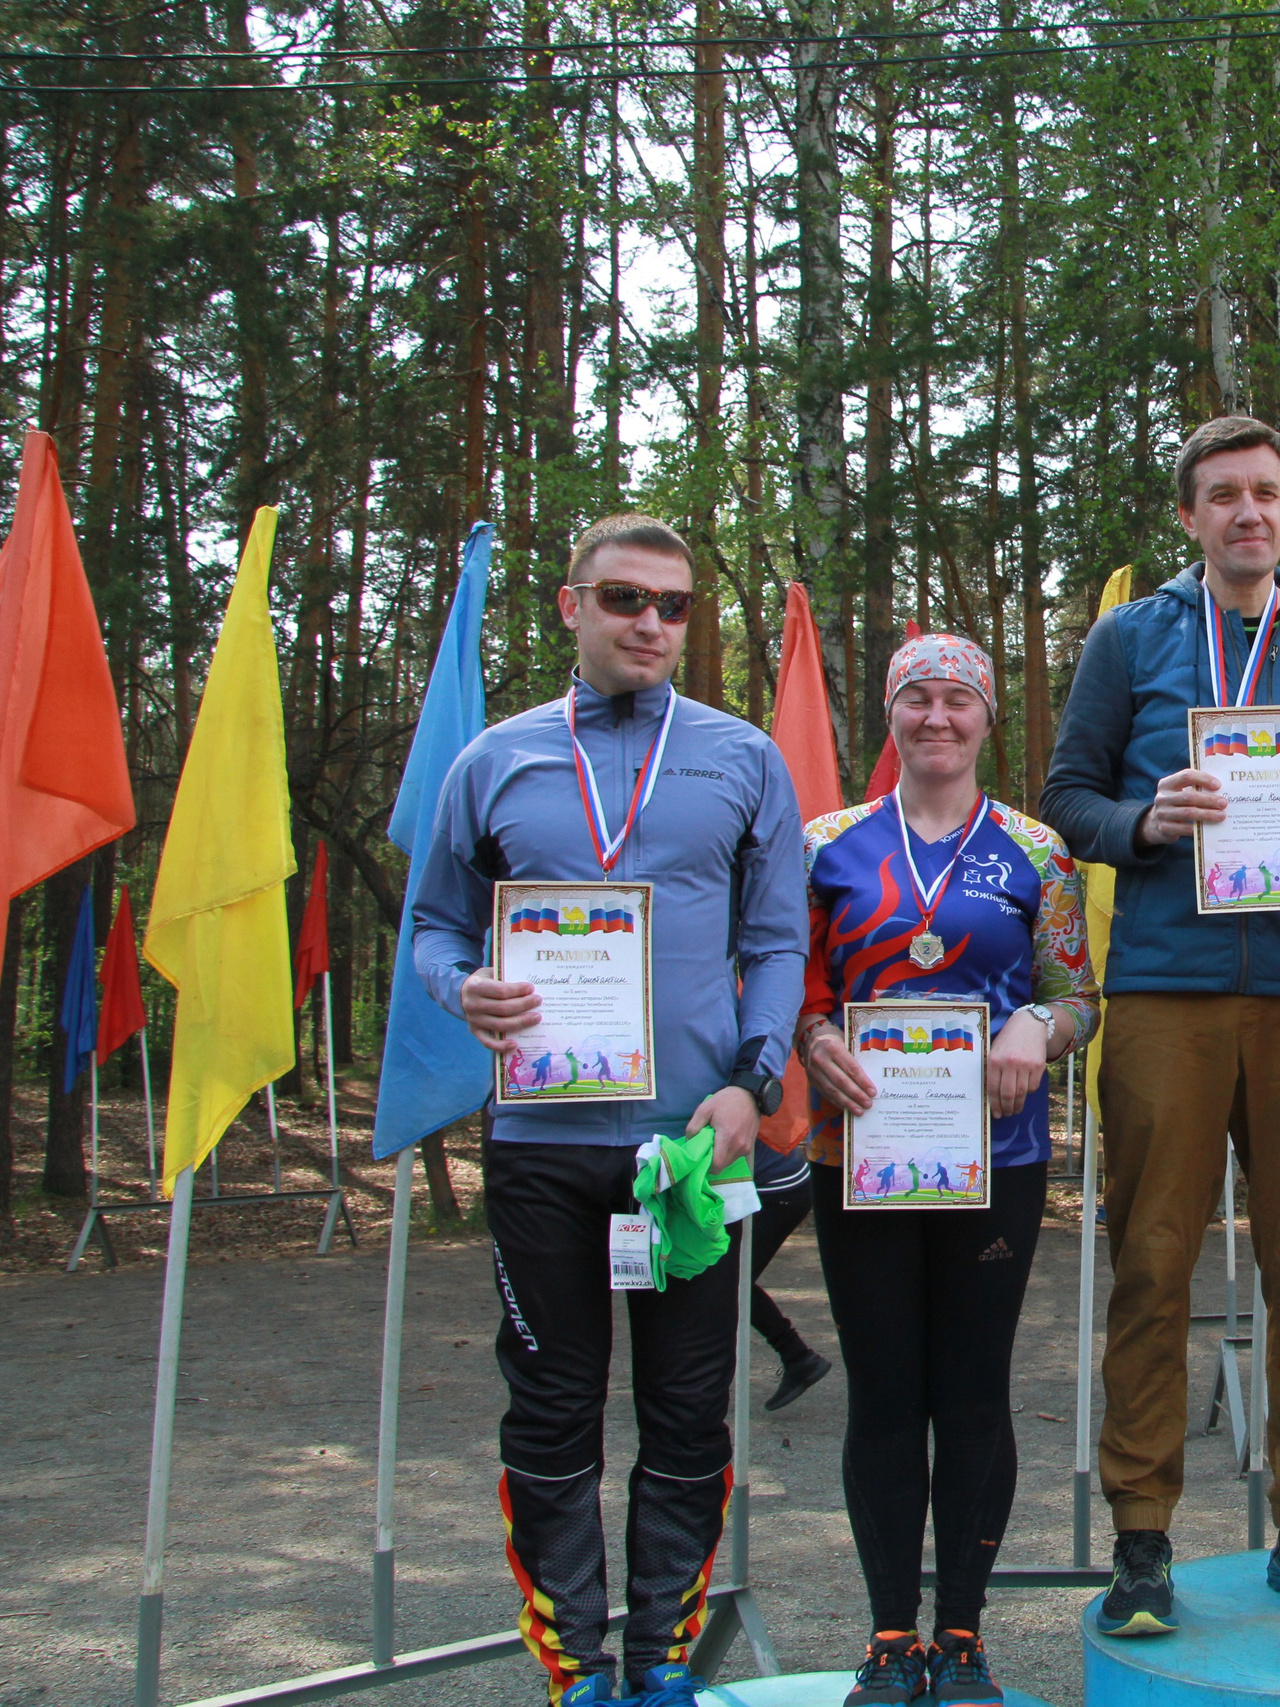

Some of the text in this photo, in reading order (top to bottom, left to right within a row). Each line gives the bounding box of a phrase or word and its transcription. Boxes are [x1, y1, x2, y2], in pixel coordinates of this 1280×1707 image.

[679, 768, 725, 781] TERREX
[939, 827, 966, 844] Южн
[537, 950, 611, 961] ГРАМОТА
[923, 945, 930, 955] 2
[883, 1067, 952, 1078] ГРАМОТА
[494, 1240, 539, 1351] ELTONEN
